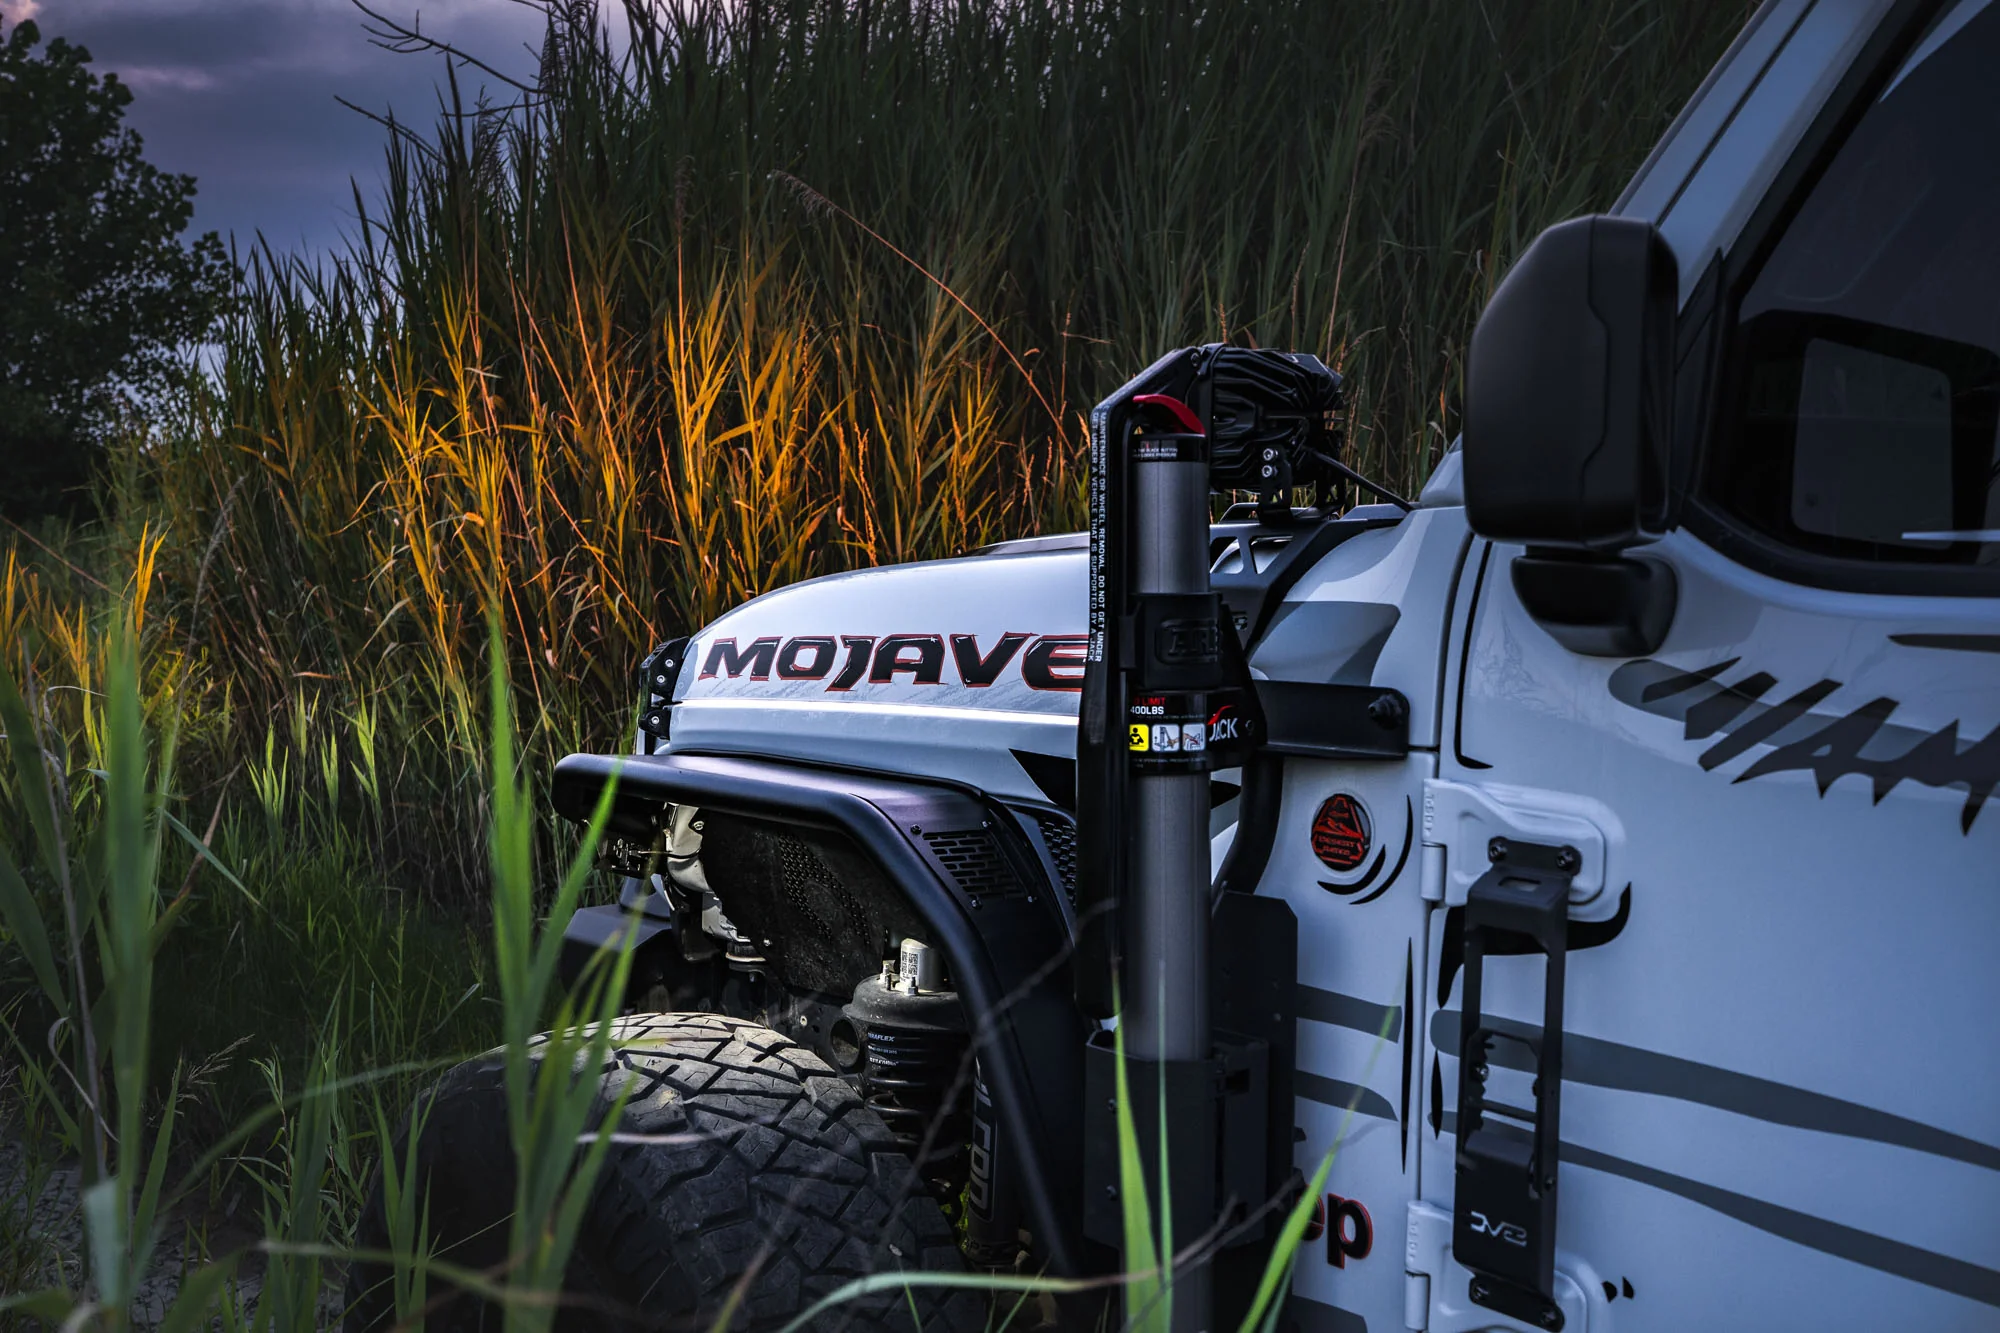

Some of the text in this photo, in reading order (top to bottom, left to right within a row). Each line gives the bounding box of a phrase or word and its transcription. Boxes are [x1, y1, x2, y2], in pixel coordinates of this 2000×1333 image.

[1099, 479, 1106, 491] OR
[1091, 543, 1097, 552] IS
[1098, 575, 1106, 588] DO
[1098, 590, 1106, 608] NOT
[1091, 612, 1097, 624] BY
[1095, 631, 1104, 662] UNDER
[698, 632, 1089, 692] MOJAVE
[1208, 717, 1240, 743] JACK
